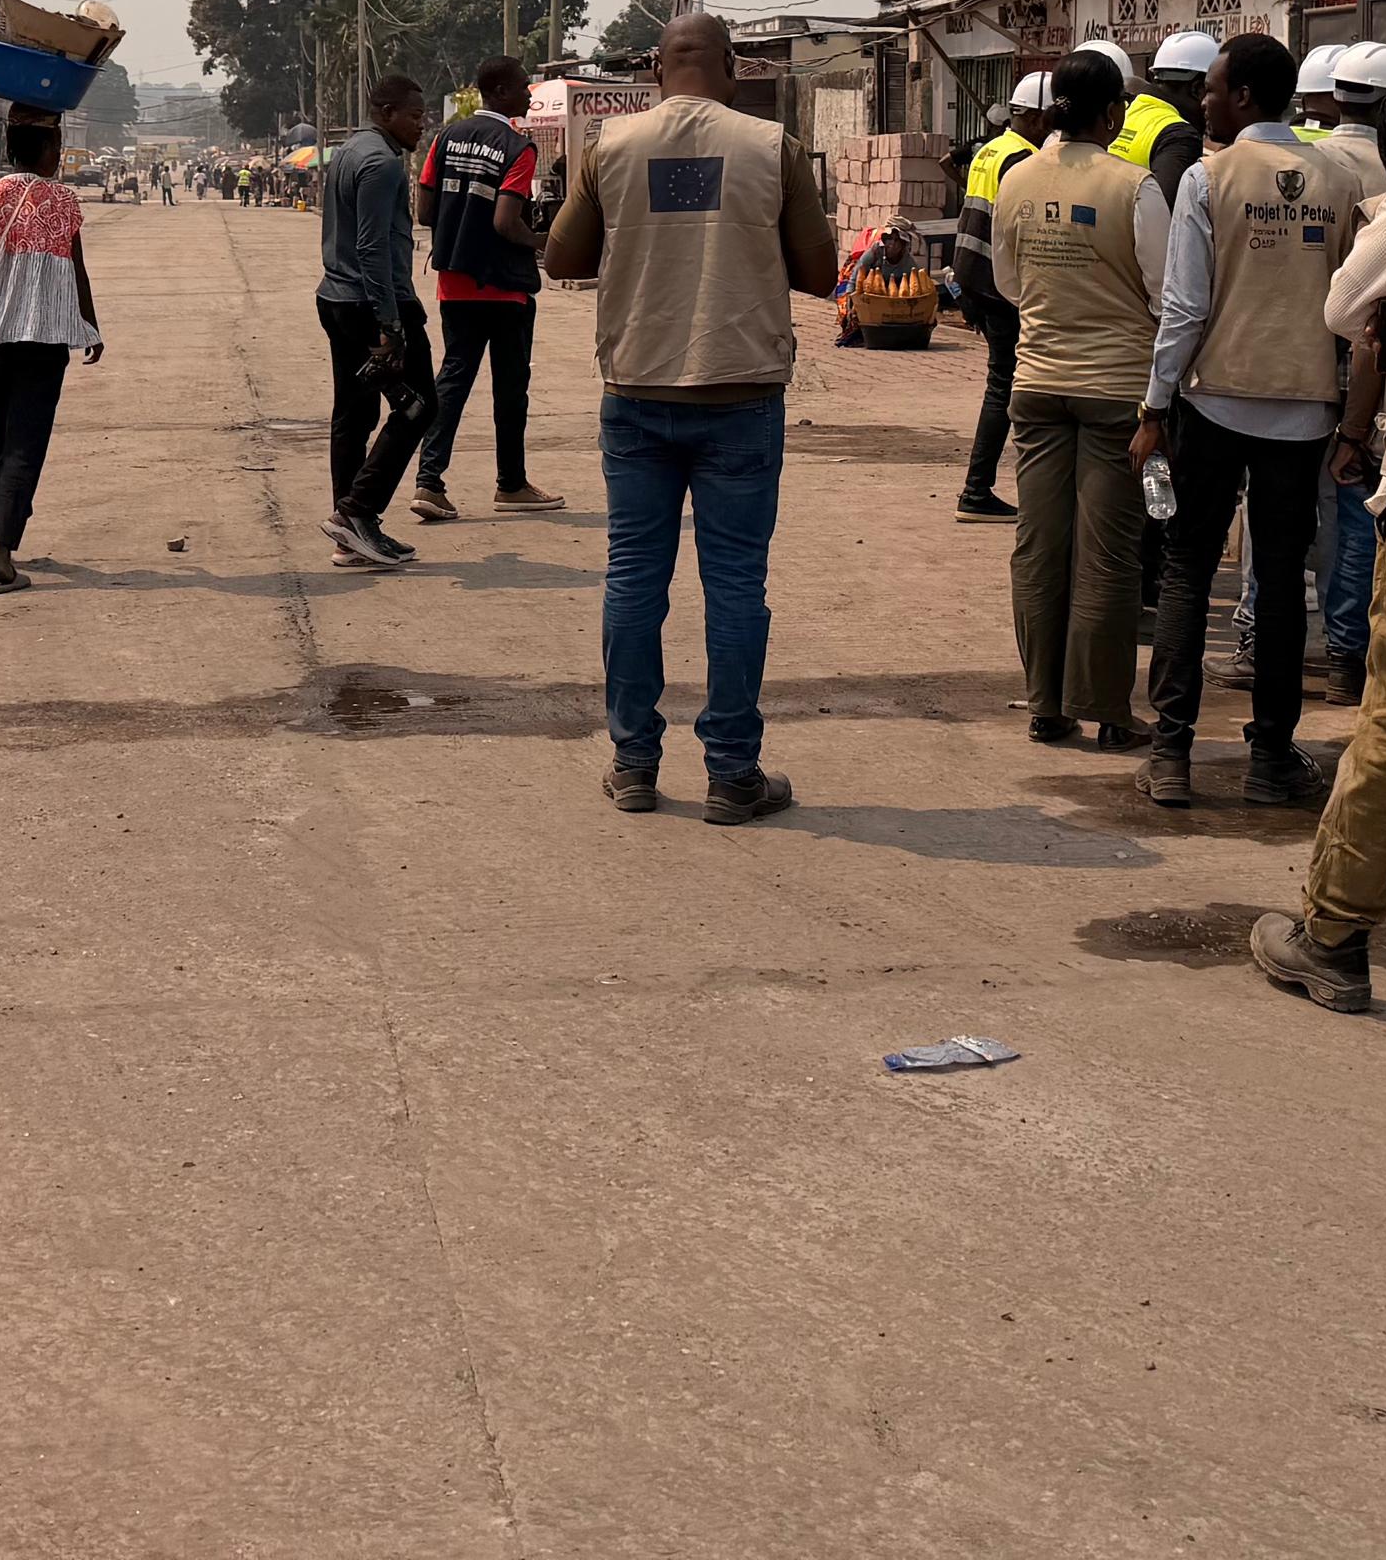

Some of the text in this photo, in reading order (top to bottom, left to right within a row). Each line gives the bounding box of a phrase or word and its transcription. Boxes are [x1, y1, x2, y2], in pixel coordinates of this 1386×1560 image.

[573, 91, 651, 117] PRESSING
[1245, 202, 1336, 224] Projet To Petola
